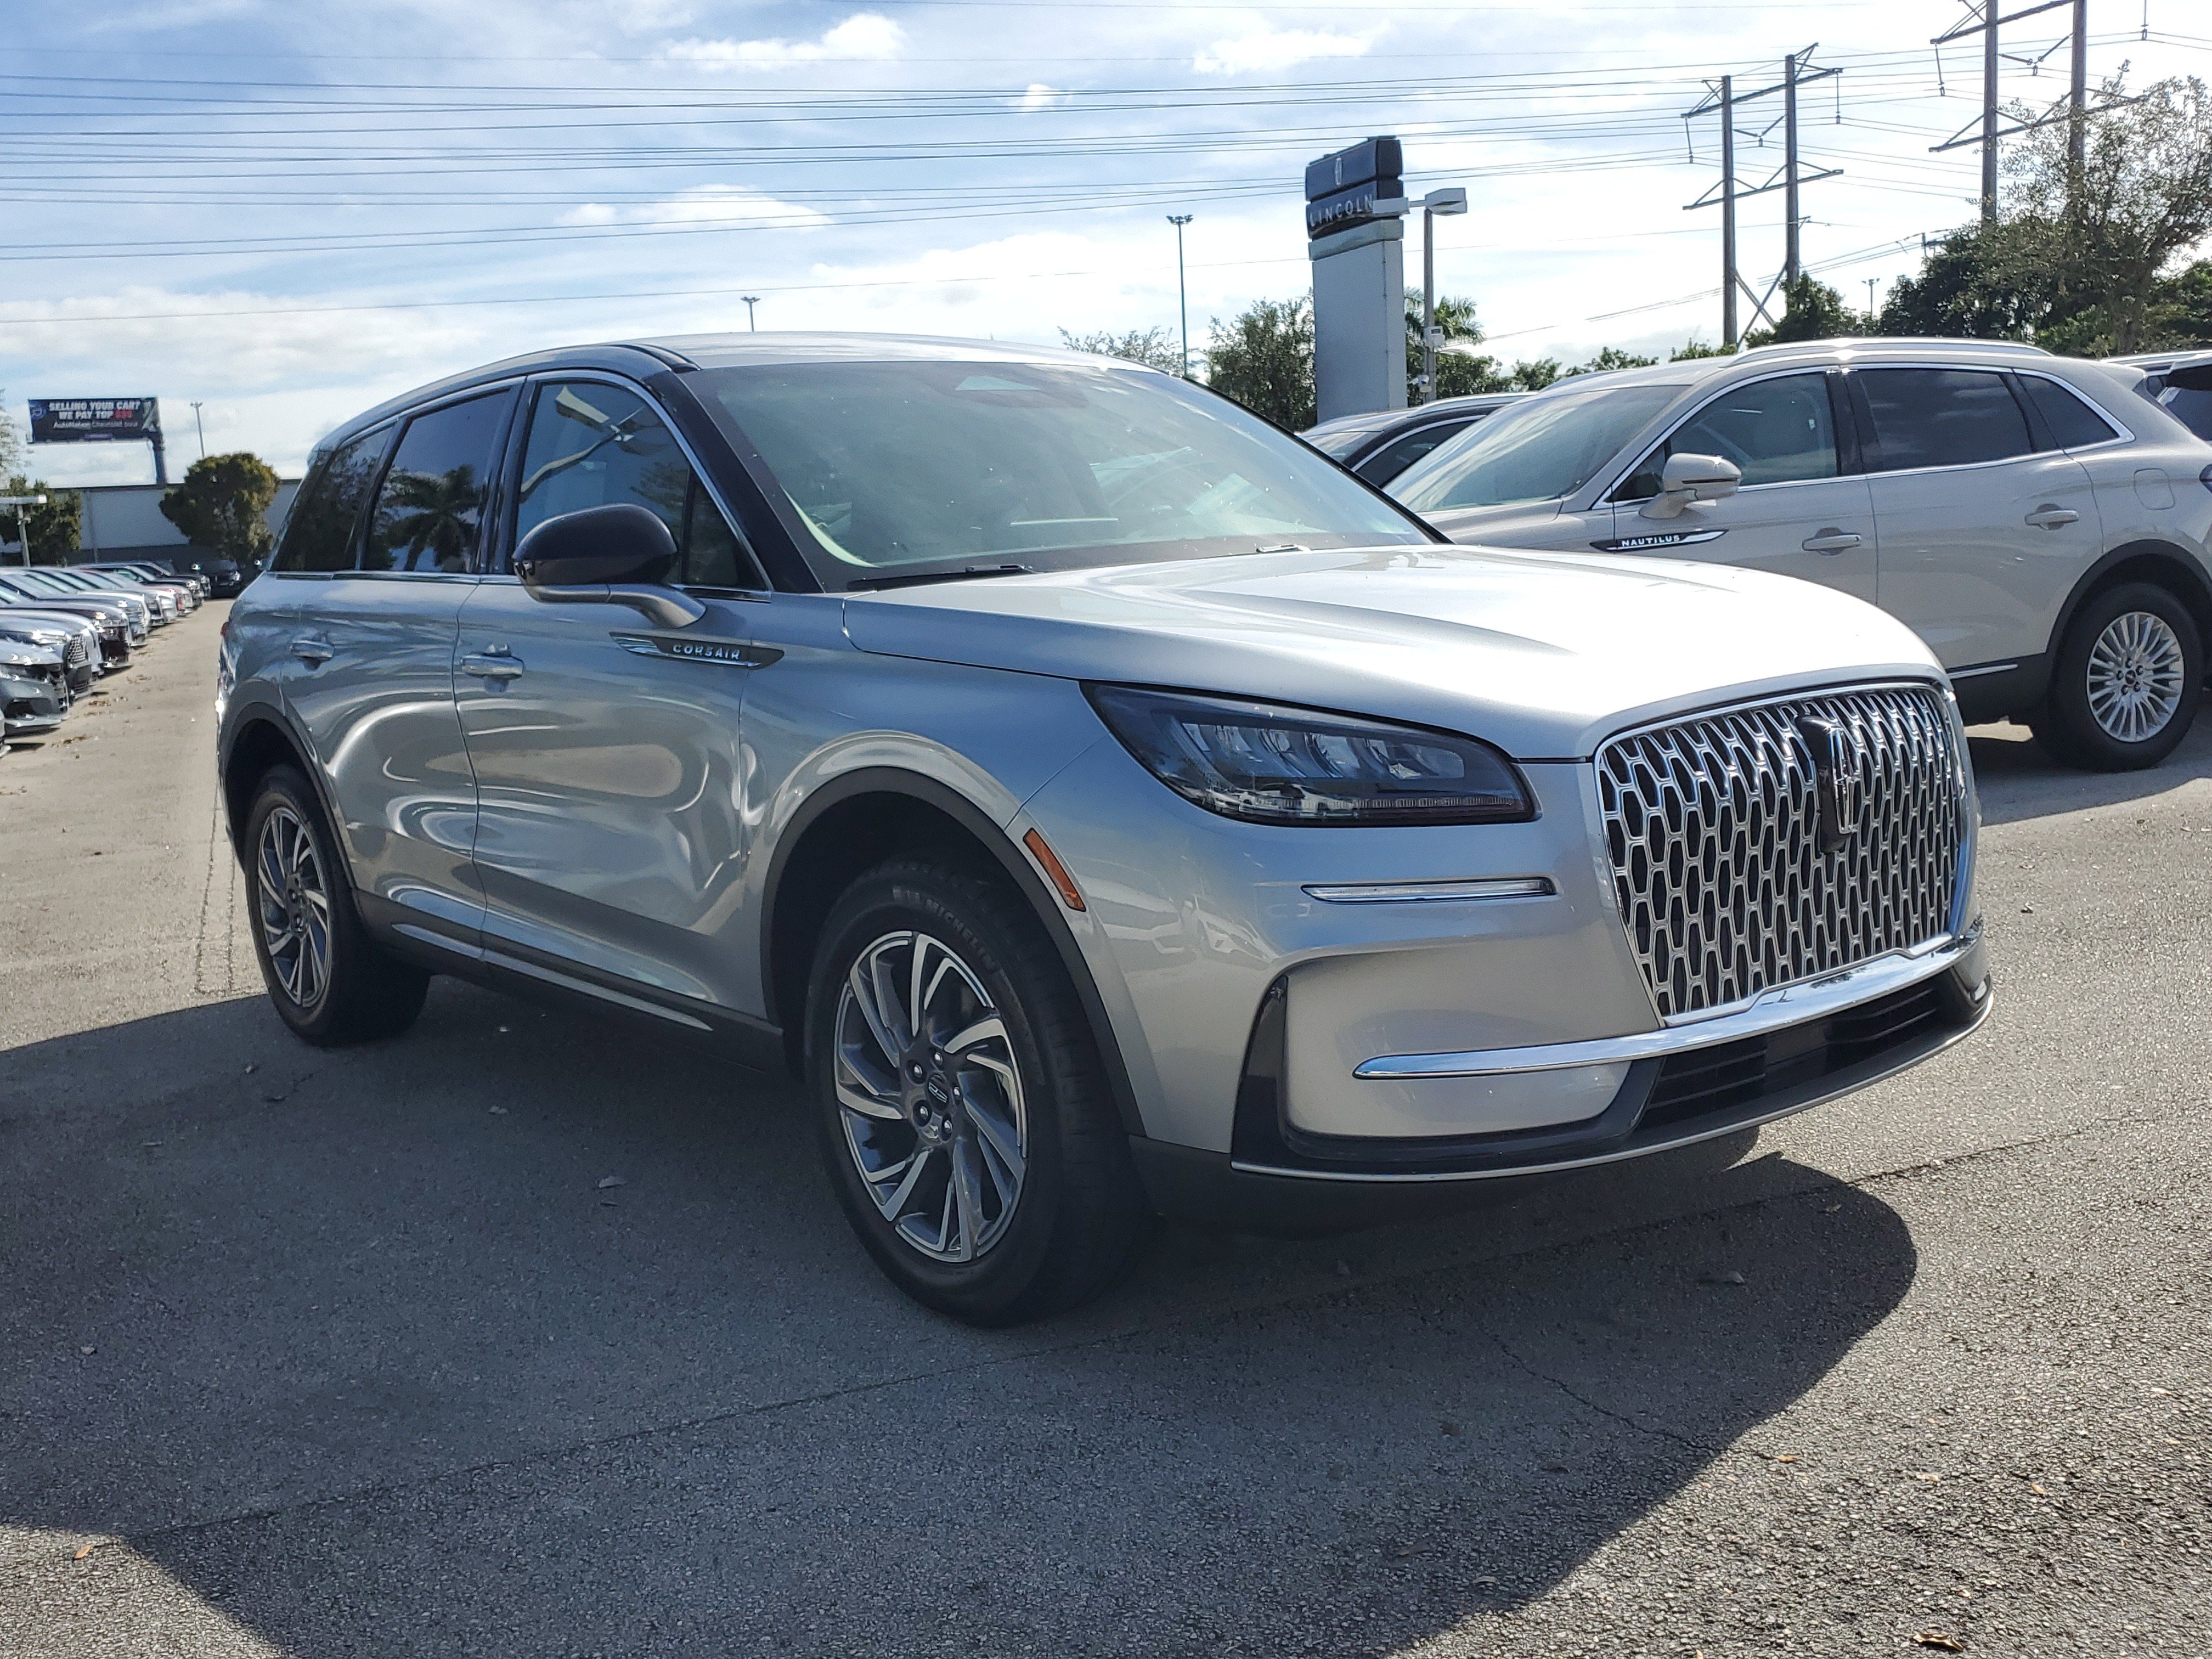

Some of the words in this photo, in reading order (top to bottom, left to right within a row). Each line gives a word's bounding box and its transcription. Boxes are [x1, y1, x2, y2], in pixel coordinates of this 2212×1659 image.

[1309, 194, 1374, 227] LINCOLN
[49, 401, 87, 411] SELLING
[89, 400, 114, 410] YOUR
[59, 411, 73, 420] WE
[75, 411, 92, 419] PAY
[97, 410, 114, 419] TOP
[1621, 535, 1680, 547] NAUTILUS
[673, 644, 741, 661] CORSAIR
[926, 898, 995, 970] MICHELIN
